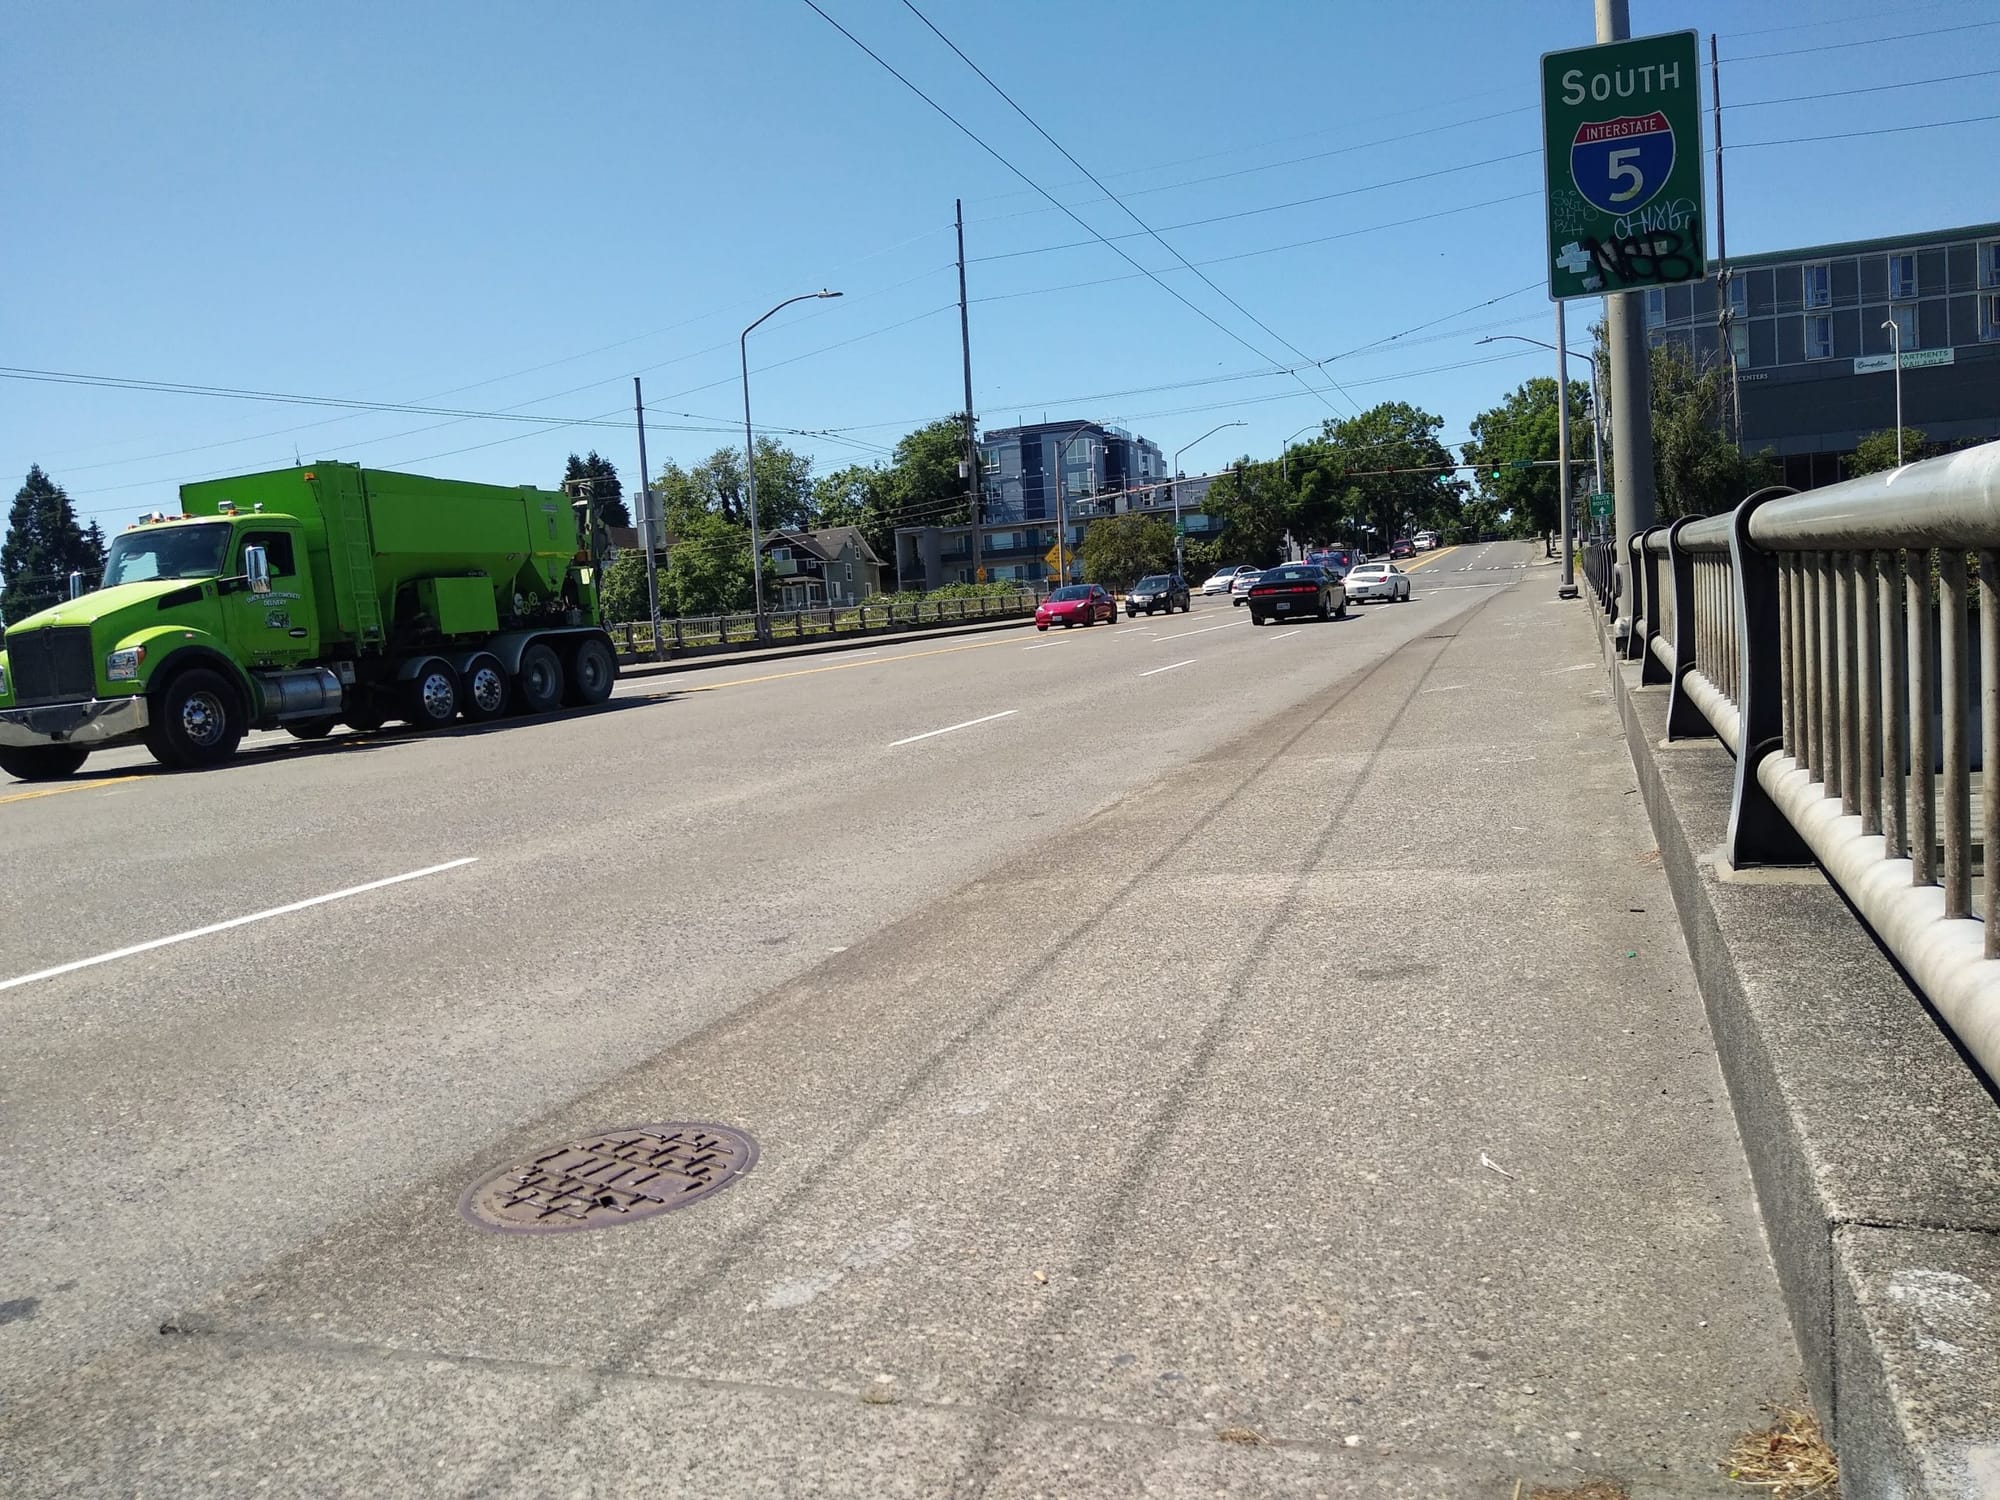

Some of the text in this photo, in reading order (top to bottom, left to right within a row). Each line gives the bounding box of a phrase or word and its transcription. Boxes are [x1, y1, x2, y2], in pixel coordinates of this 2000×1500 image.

[1561, 60, 1680, 106] SOUTH
[1586, 118, 1657, 141] INTERSTATE
[1608, 146, 1644, 202] 5
